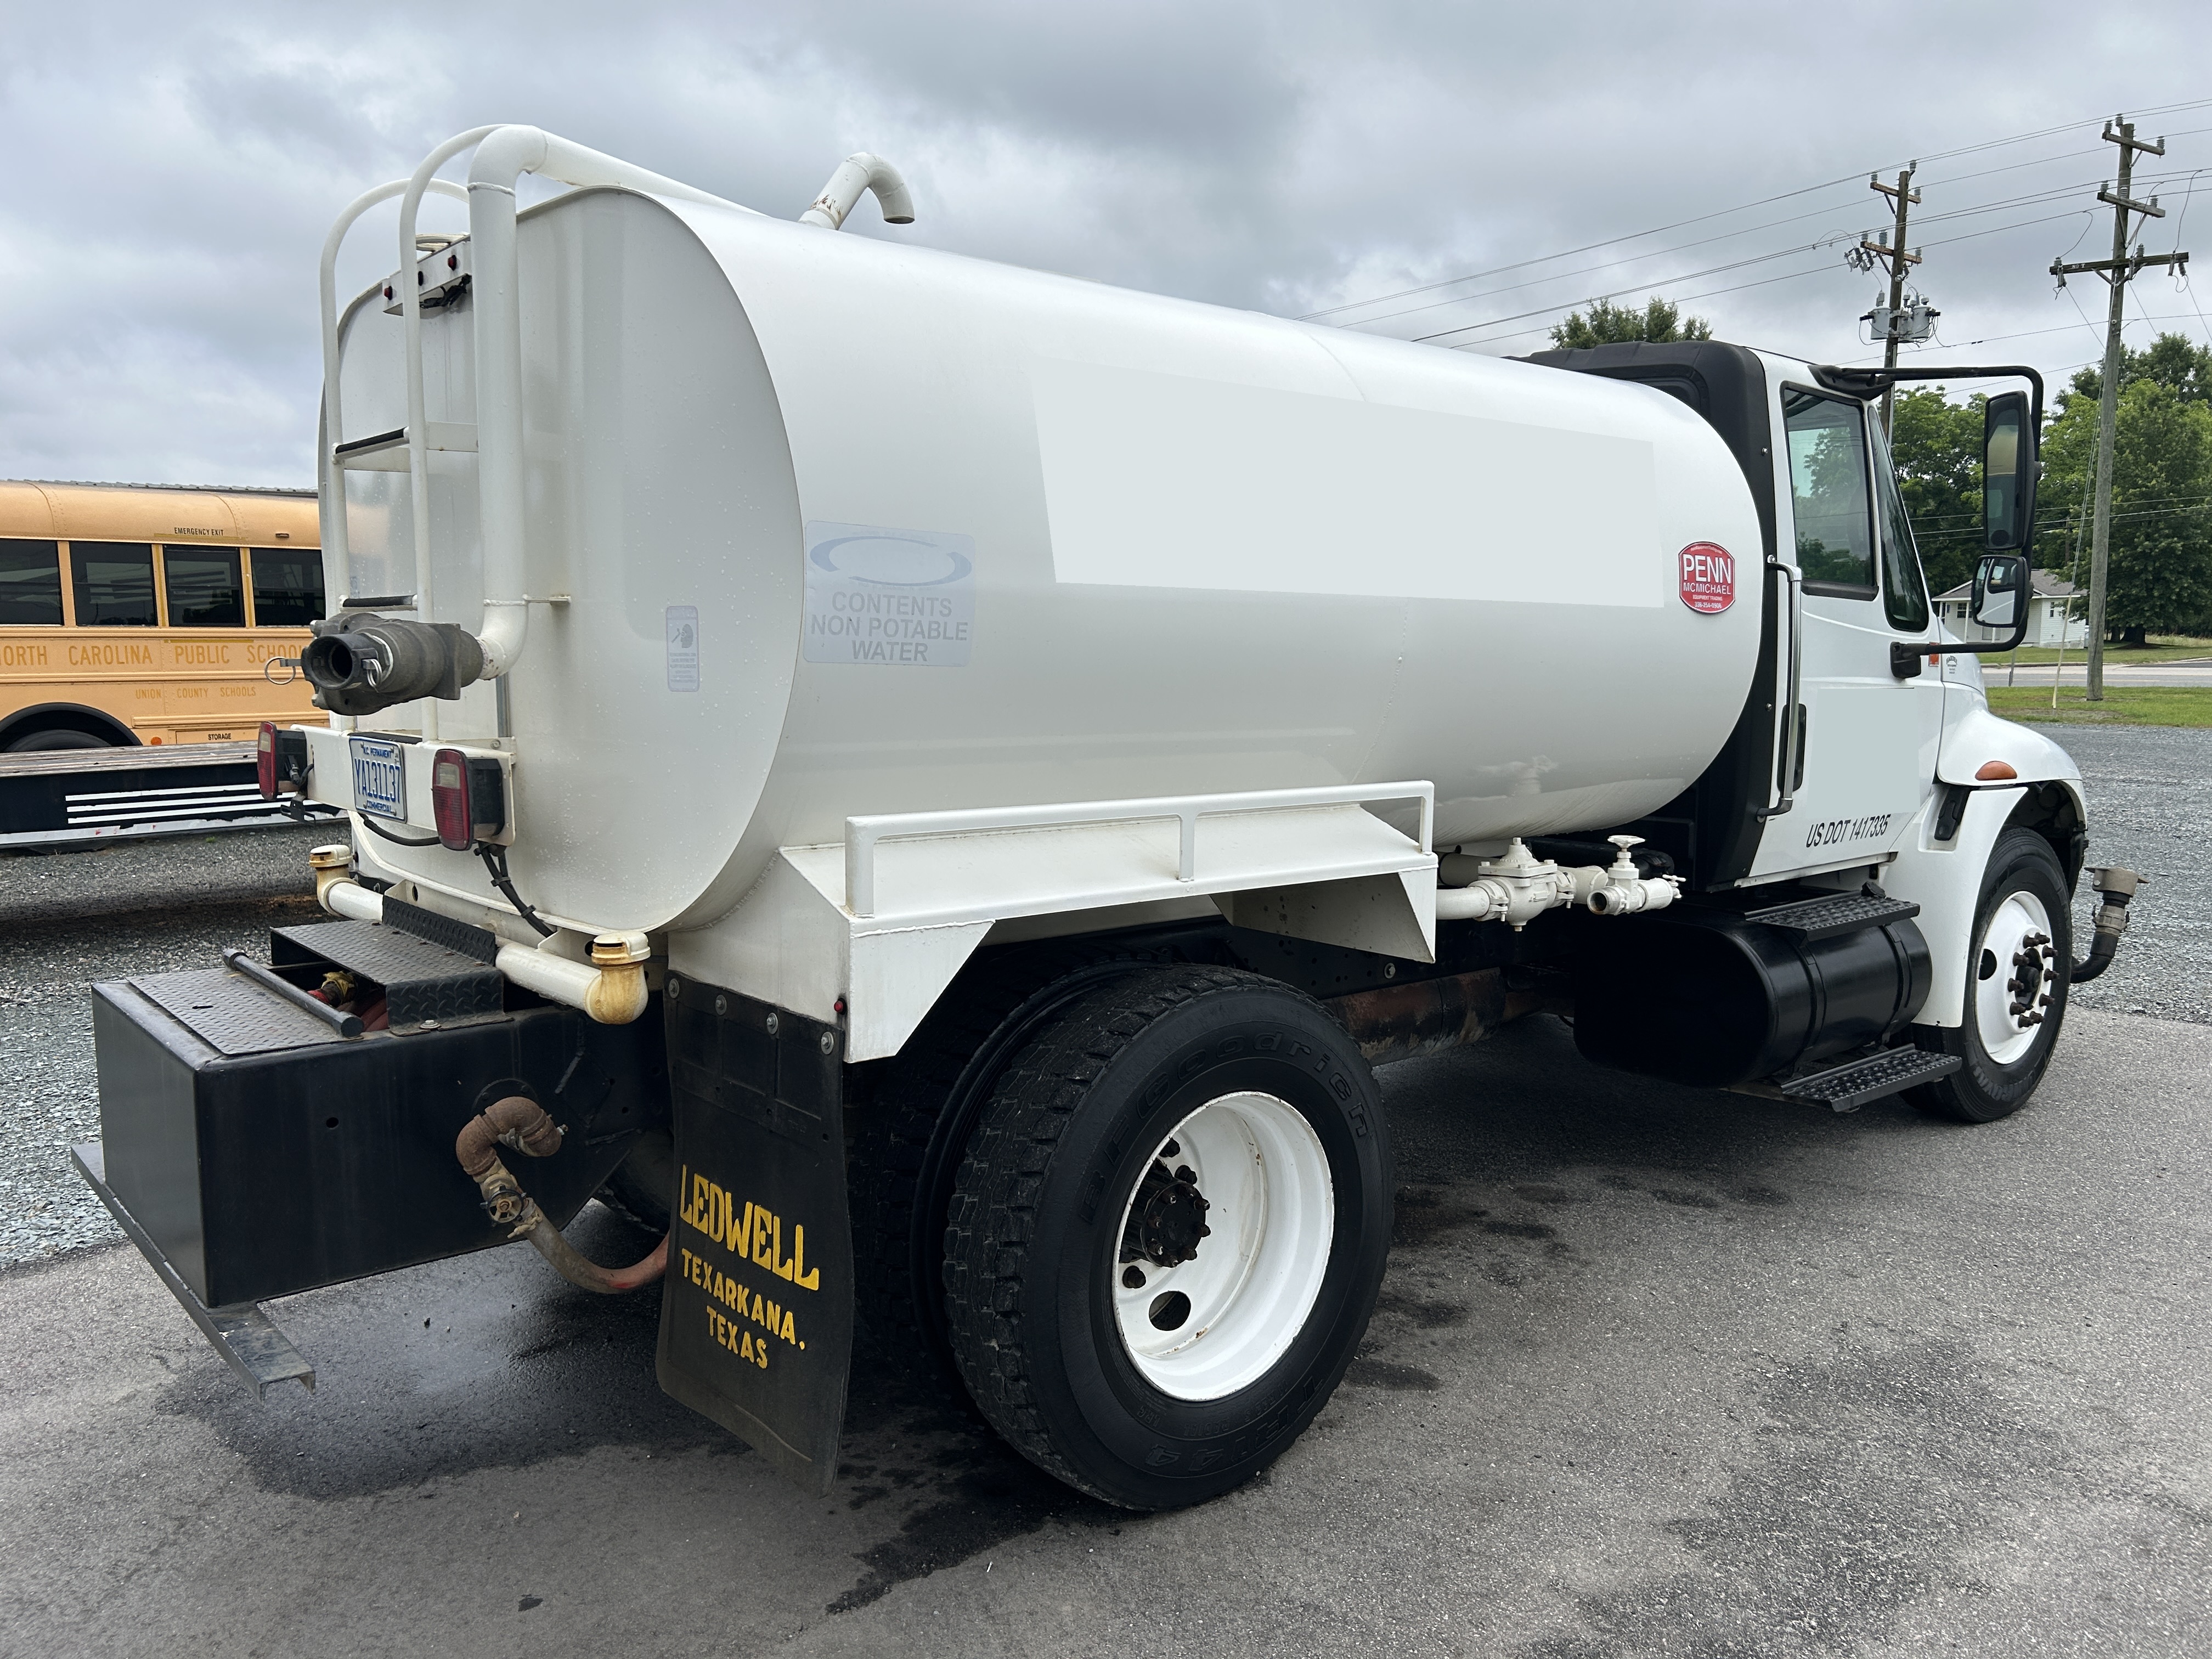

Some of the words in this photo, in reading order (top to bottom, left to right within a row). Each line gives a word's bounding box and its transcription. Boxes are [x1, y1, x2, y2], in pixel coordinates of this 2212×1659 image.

[174, 527, 210, 535] EMERGENCY
[1683, 553, 1732, 584] PENN
[1683, 582, 1731, 595] MCMICHAEL
[832, 591, 952, 618] CONTENTS
[811, 614, 861, 636] NON
[868, 617, 968, 641] POTABLE
[0, 645, 48, 666] ORTH
[68, 645, 153, 665] CAROLINA
[174, 645, 230, 664] PUBLIC
[851, 640, 928, 662] WATER
[136, 689, 162, 699] UNION
[177, 687, 208, 698] COUNTY
[220, 686, 256, 697] SCHOOLS
[354, 757, 400, 804] YA131137
[1806, 822, 1825, 848] US
[1823, 819, 1852, 845] DOT
[1849, 814, 1891, 841] 1417335
[680, 1164, 820, 1291] LEDWELL
[681, 1248, 806, 1350] TEXARKANA.
[706, 1305, 768, 1369] TEXAS
